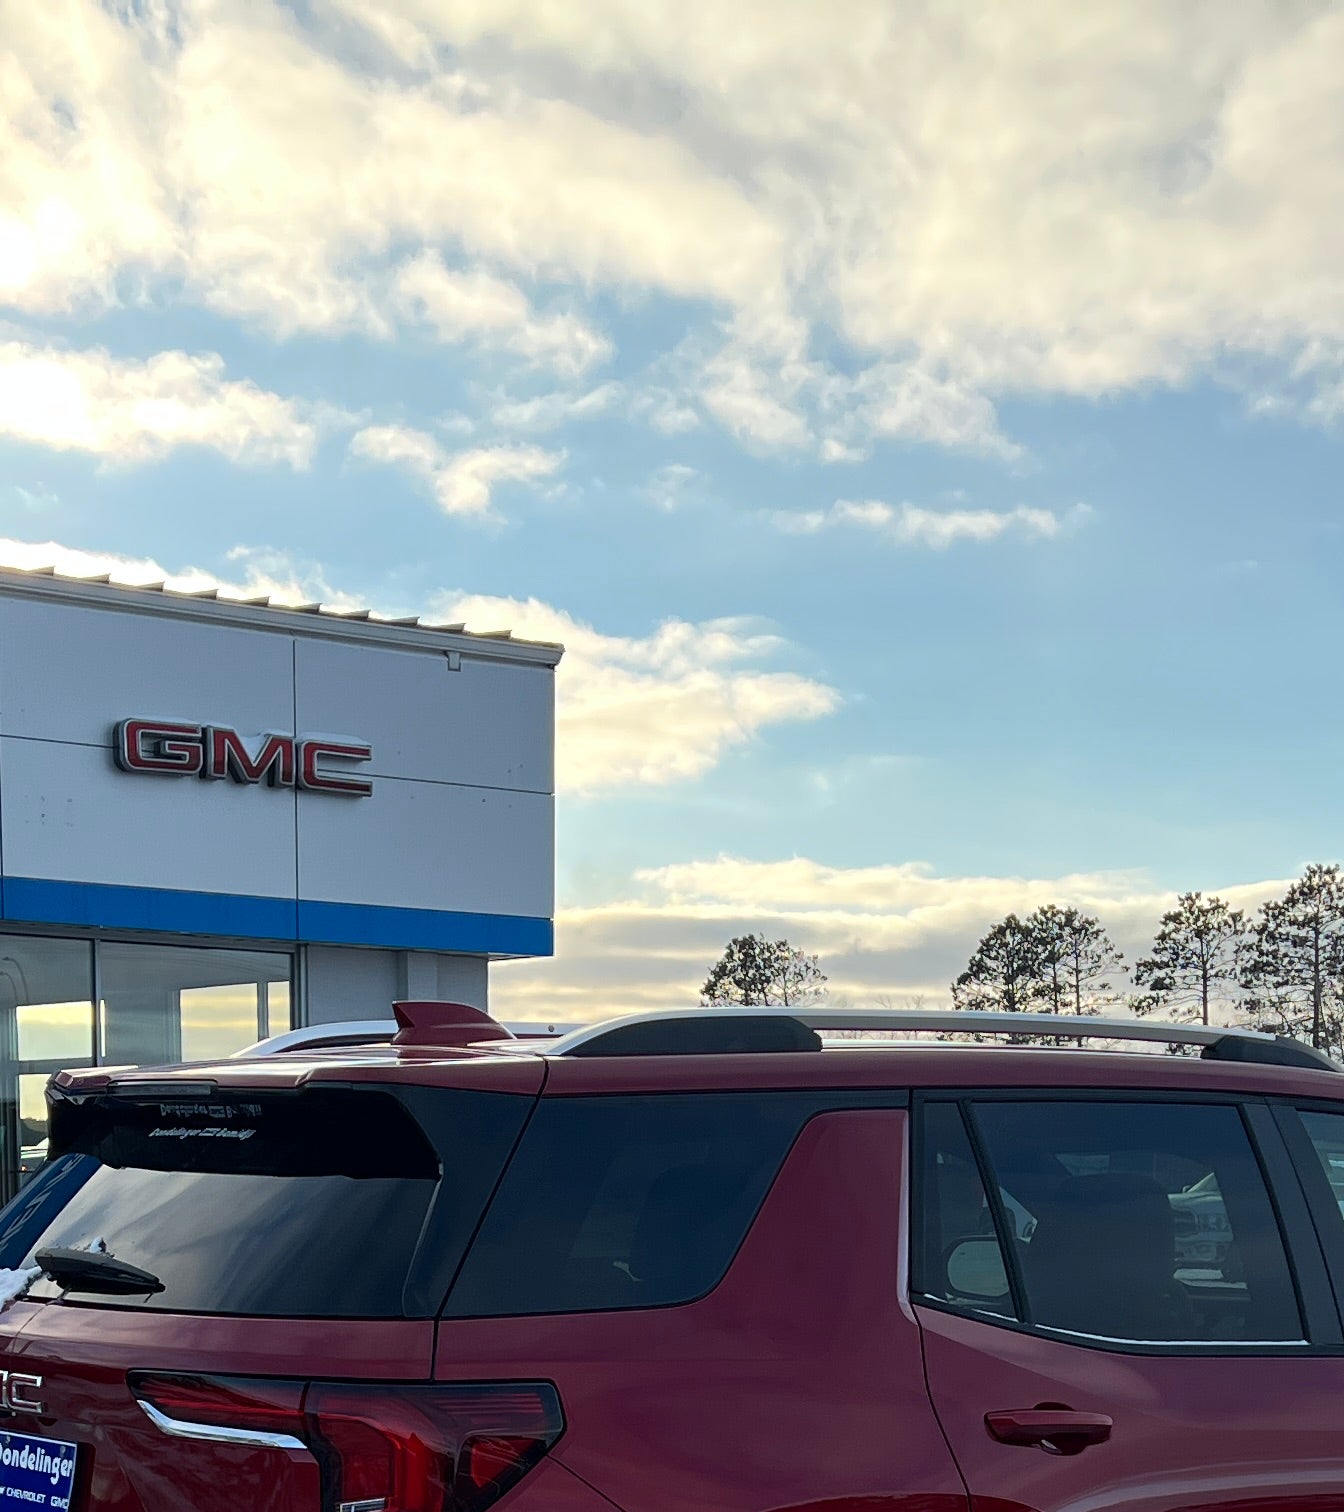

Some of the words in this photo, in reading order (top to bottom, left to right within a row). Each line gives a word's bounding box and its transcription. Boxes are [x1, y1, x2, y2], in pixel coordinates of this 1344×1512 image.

[113, 717, 373, 797] GMC
[6, 1488, 46, 1504] CHEVROLET
[50, 1496, 70, 1510] GMC
